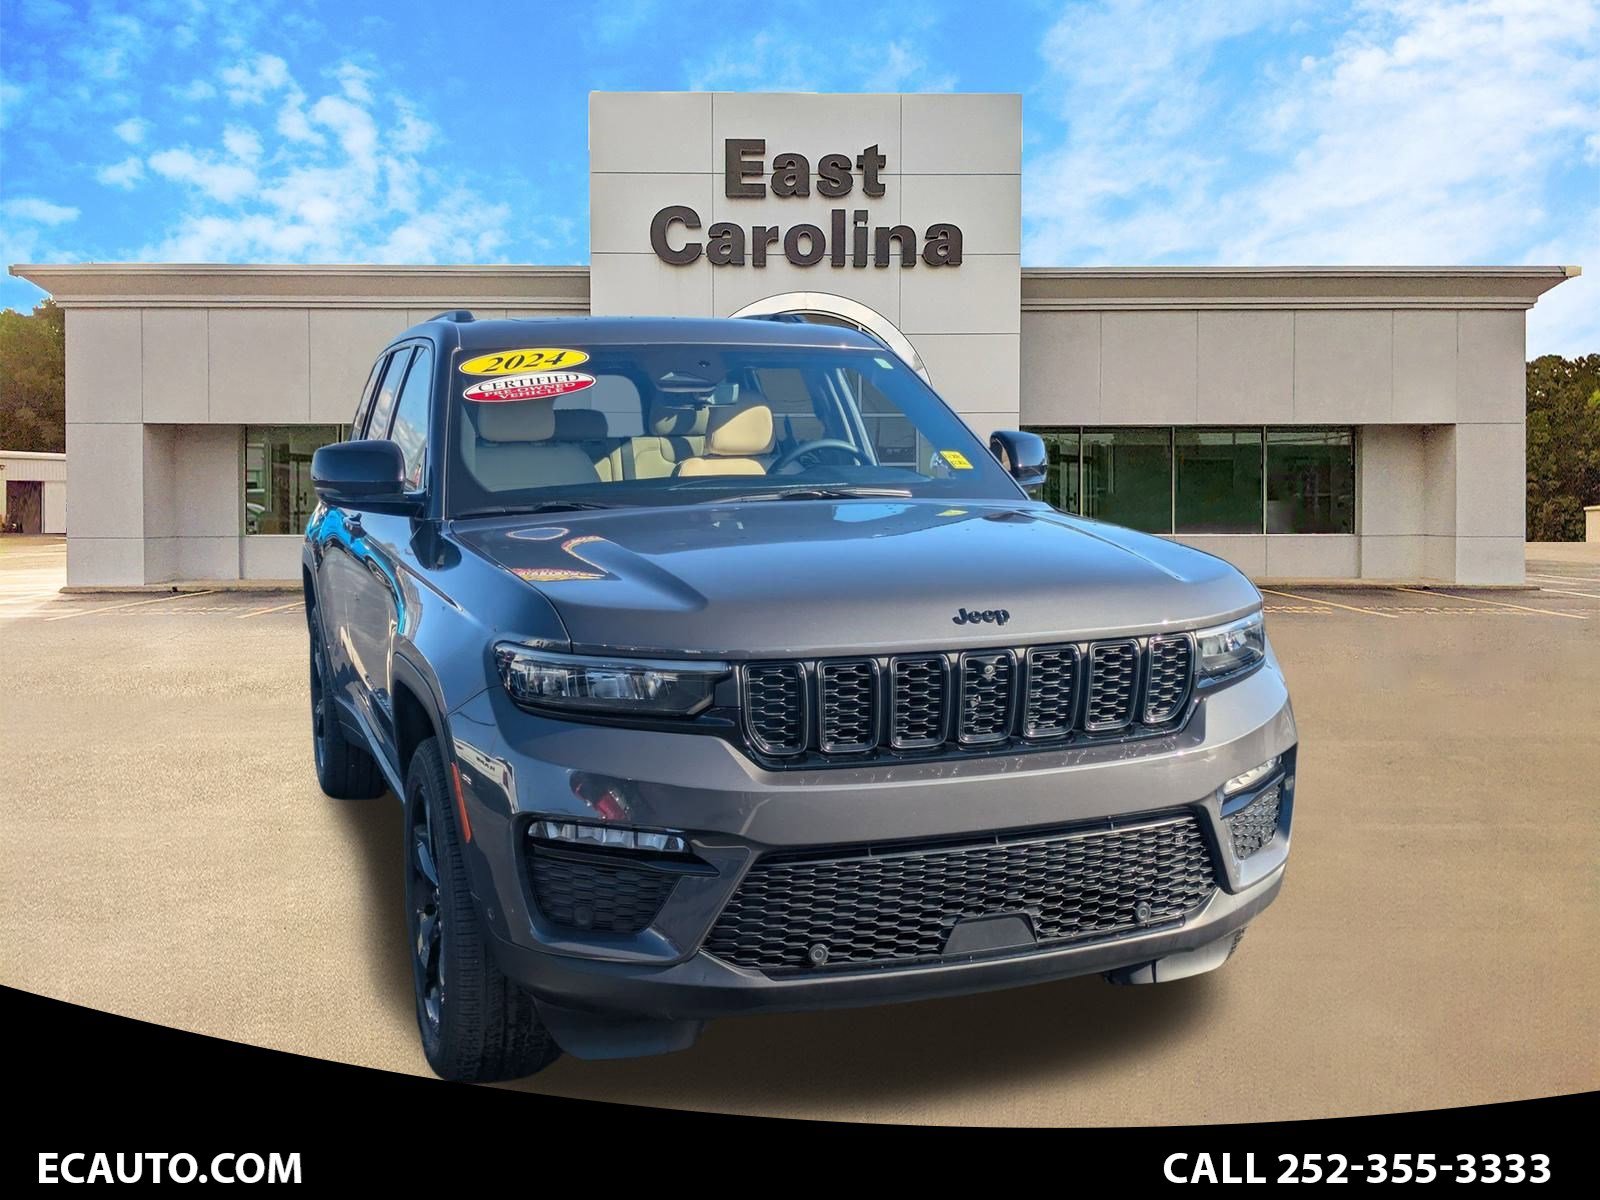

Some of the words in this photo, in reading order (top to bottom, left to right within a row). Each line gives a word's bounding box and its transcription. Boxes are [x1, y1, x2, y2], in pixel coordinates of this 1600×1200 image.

[725, 139, 886, 199] East
[650, 205, 963, 268] Carolina
[481, 351, 567, 373] 2024
[478, 374, 579, 392] CERTIFIED
[500, 387, 564, 399] VEHICLE
[952, 608, 1010, 625] Jeep
